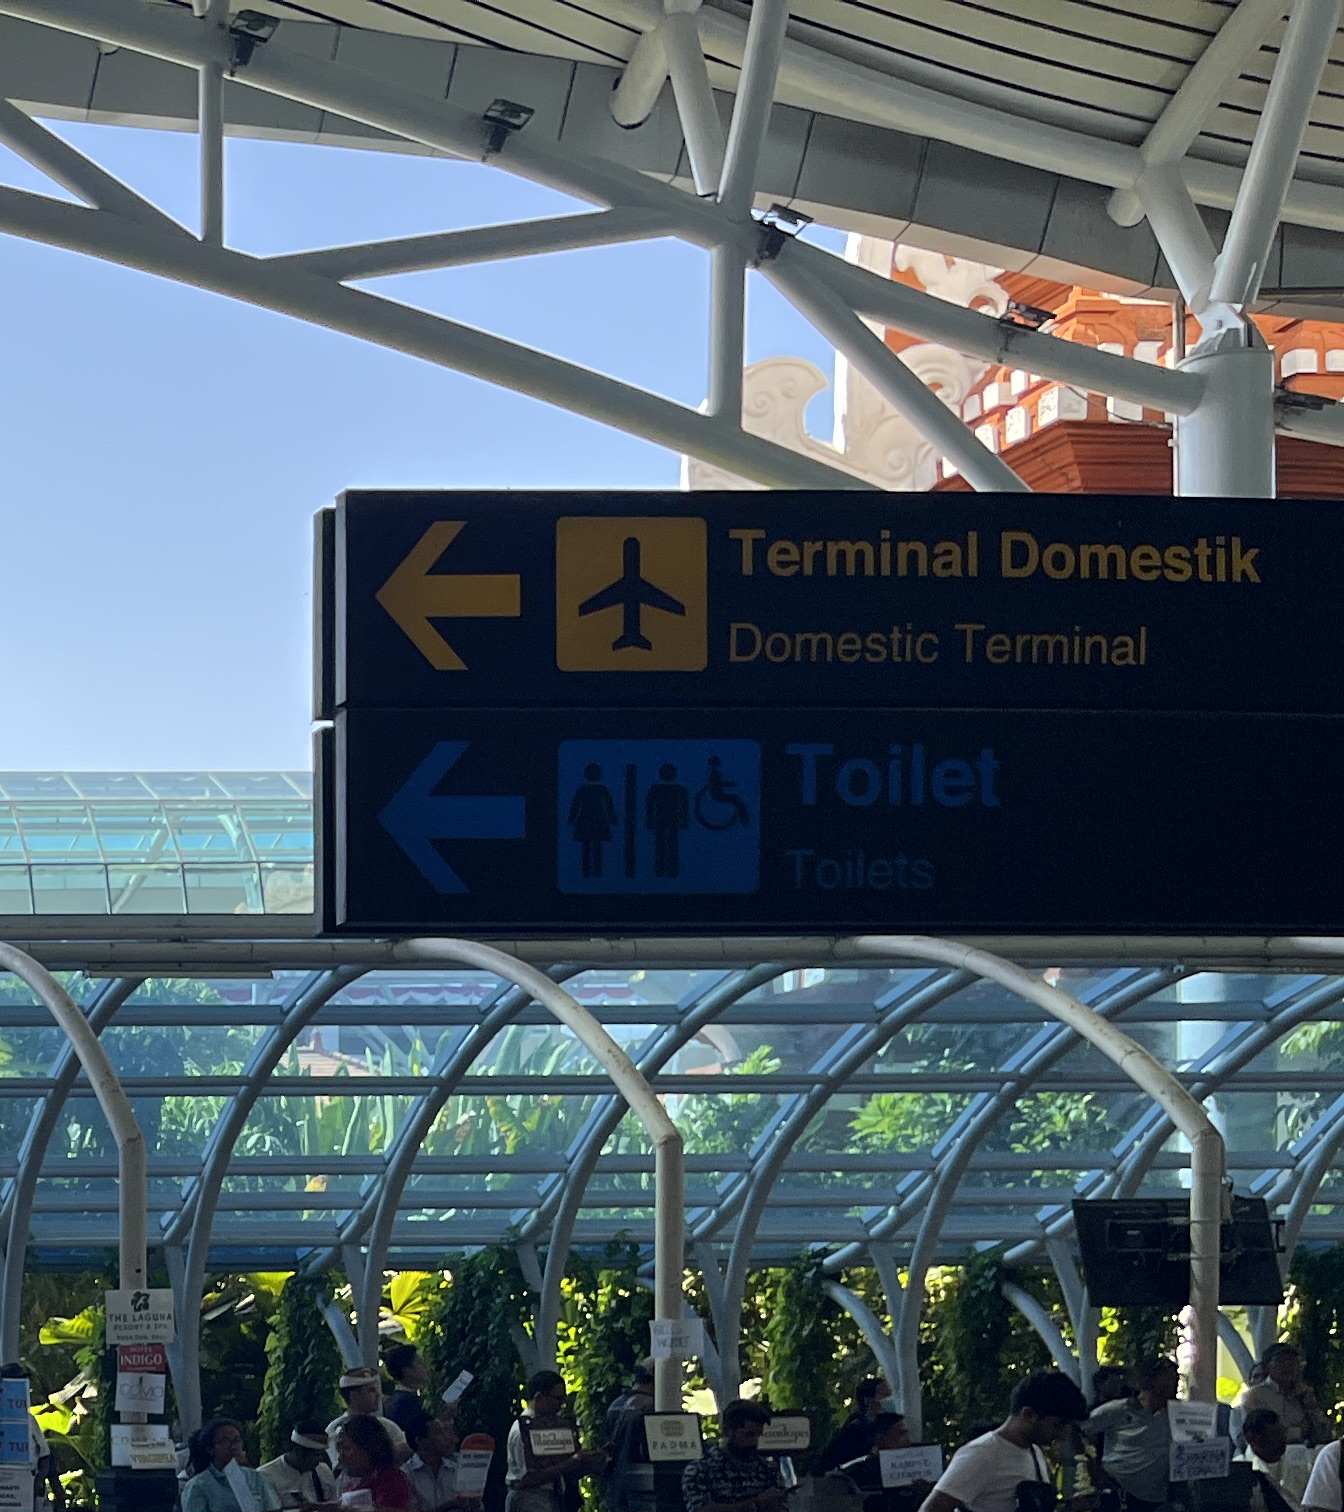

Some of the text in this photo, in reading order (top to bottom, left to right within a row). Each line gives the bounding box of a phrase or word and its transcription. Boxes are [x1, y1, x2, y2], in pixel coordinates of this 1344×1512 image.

[727, 528, 1262, 584] Terminal Domestik
[727, 621, 1148, 666] Domestic Terminal
[785, 742, 1002, 808] Toilet
[785, 848, 935, 891] Toilets
[109, 1313, 128, 1323] THE
[120, 1353, 163, 1366] INDIGO
